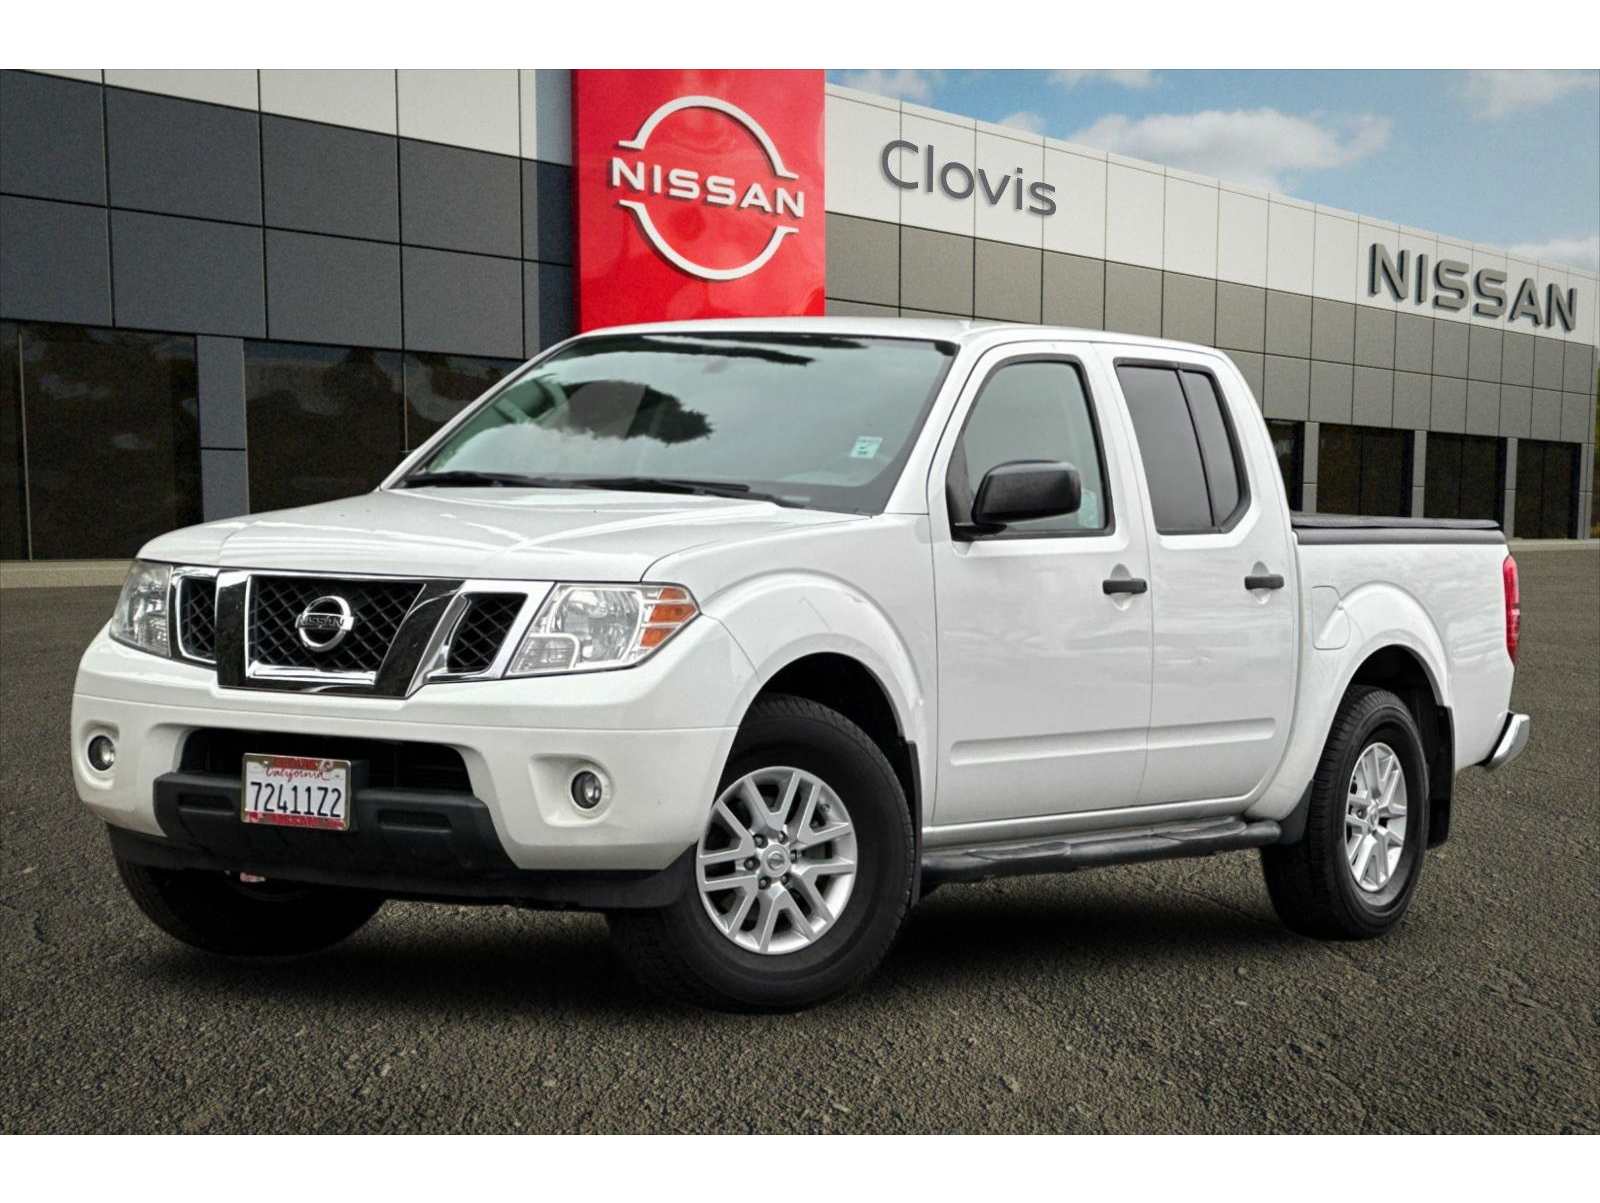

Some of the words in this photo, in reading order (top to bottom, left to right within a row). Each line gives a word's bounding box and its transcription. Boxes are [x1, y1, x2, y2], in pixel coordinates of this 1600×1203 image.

[612, 156, 804, 218] NISSAN
[880, 139, 1057, 216] Clovis
[1368, 242, 1578, 332] NISSAN
[250, 781, 342, 818] 72411Z2
[265, 766, 329, 782] California
